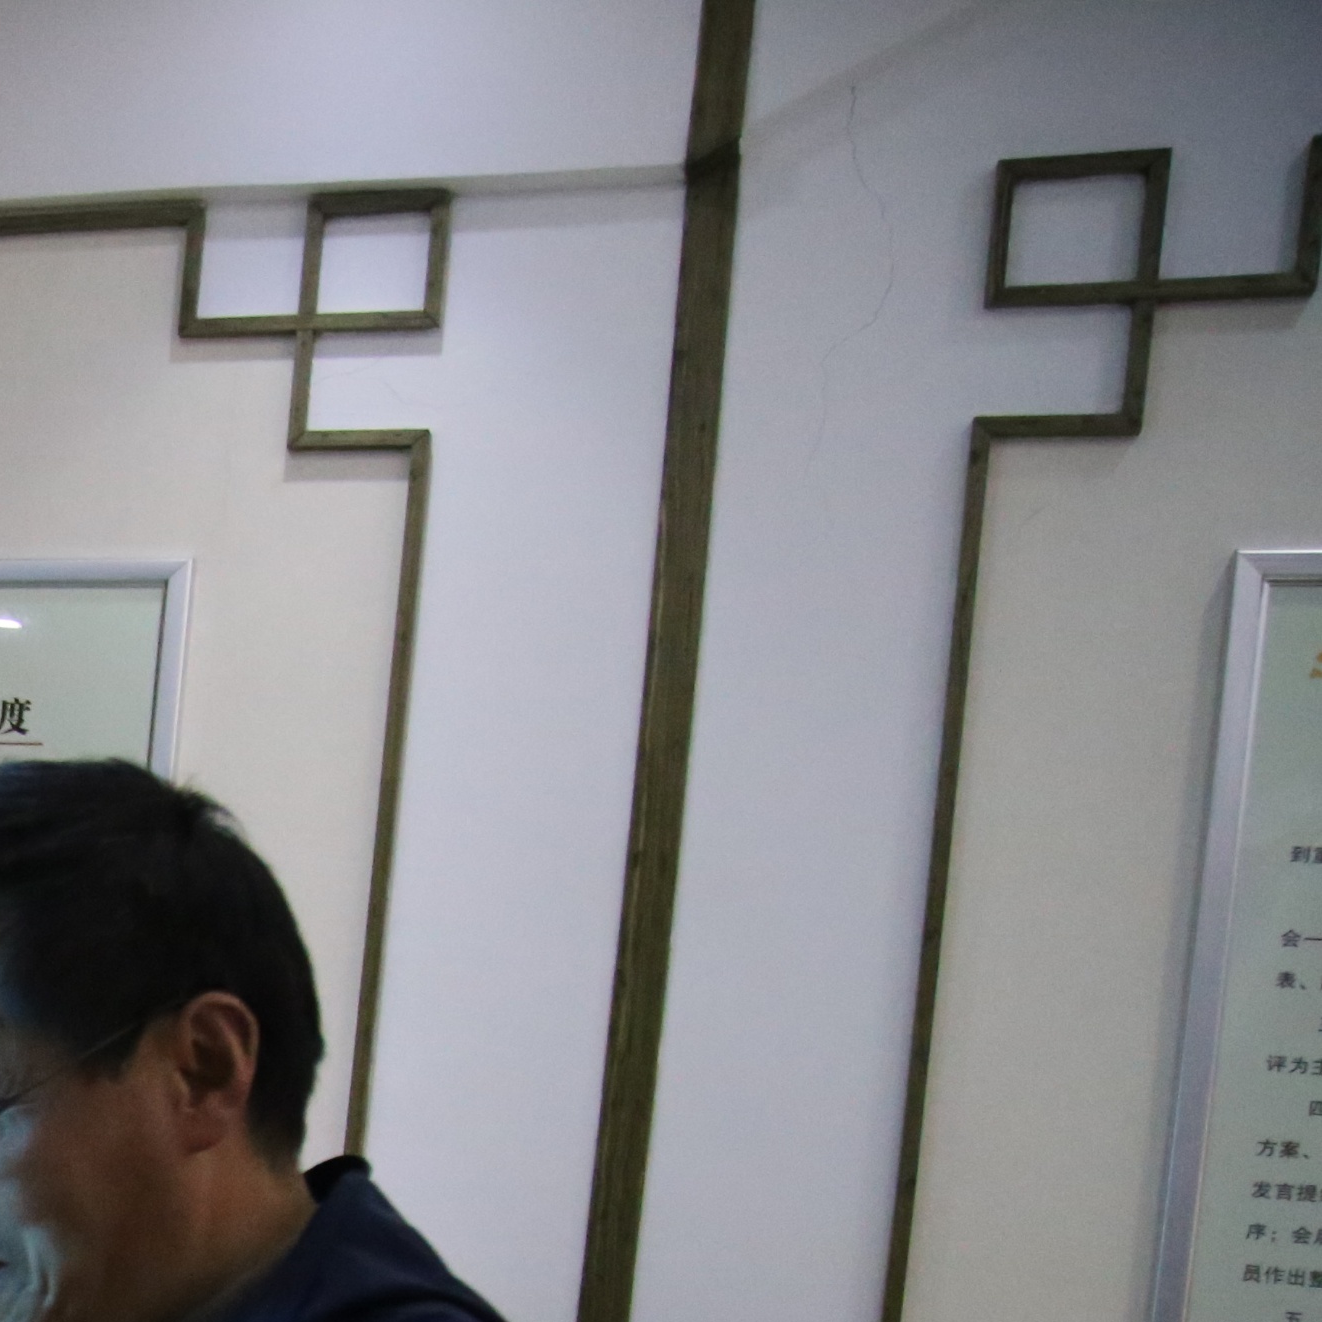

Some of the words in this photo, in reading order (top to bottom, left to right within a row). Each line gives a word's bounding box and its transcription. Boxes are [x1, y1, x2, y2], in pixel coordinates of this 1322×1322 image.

[1257, 1138, 1310, 1160] 方案、
[1252, 1181, 1322, 1203] 发言提
